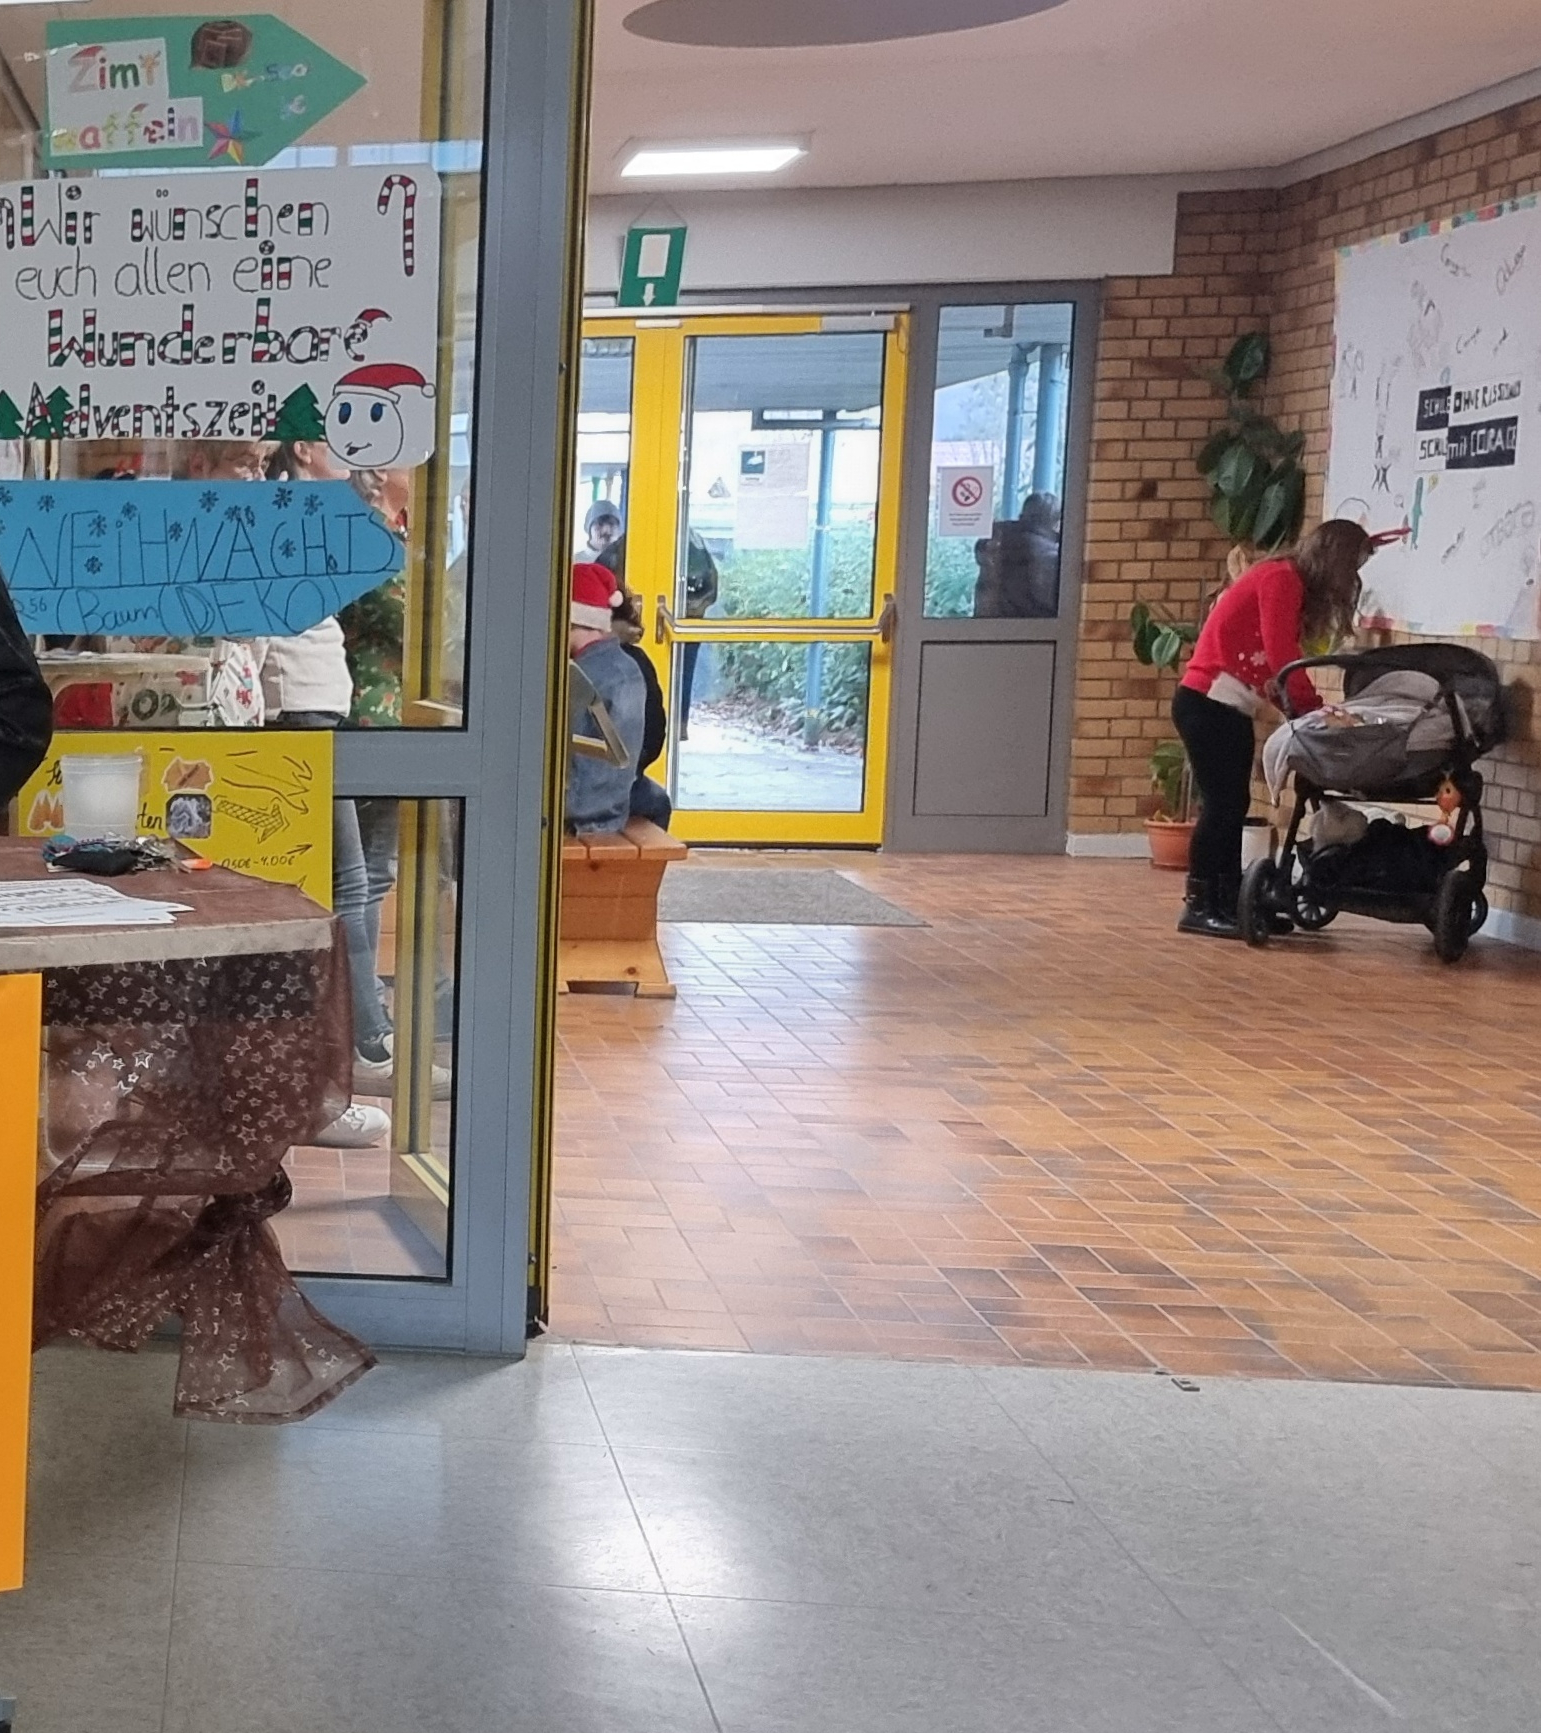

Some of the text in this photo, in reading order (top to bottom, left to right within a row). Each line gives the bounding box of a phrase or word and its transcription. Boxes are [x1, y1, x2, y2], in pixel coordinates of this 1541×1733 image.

[68, 46, 161, 93] Zimt
[20, 177, 329, 247] Wir wünschen
[15, 239, 332, 300] euch allen eine
[47, 298, 371, 368] Wunderbare
[24, 381, 279, 440] Adventszeit
